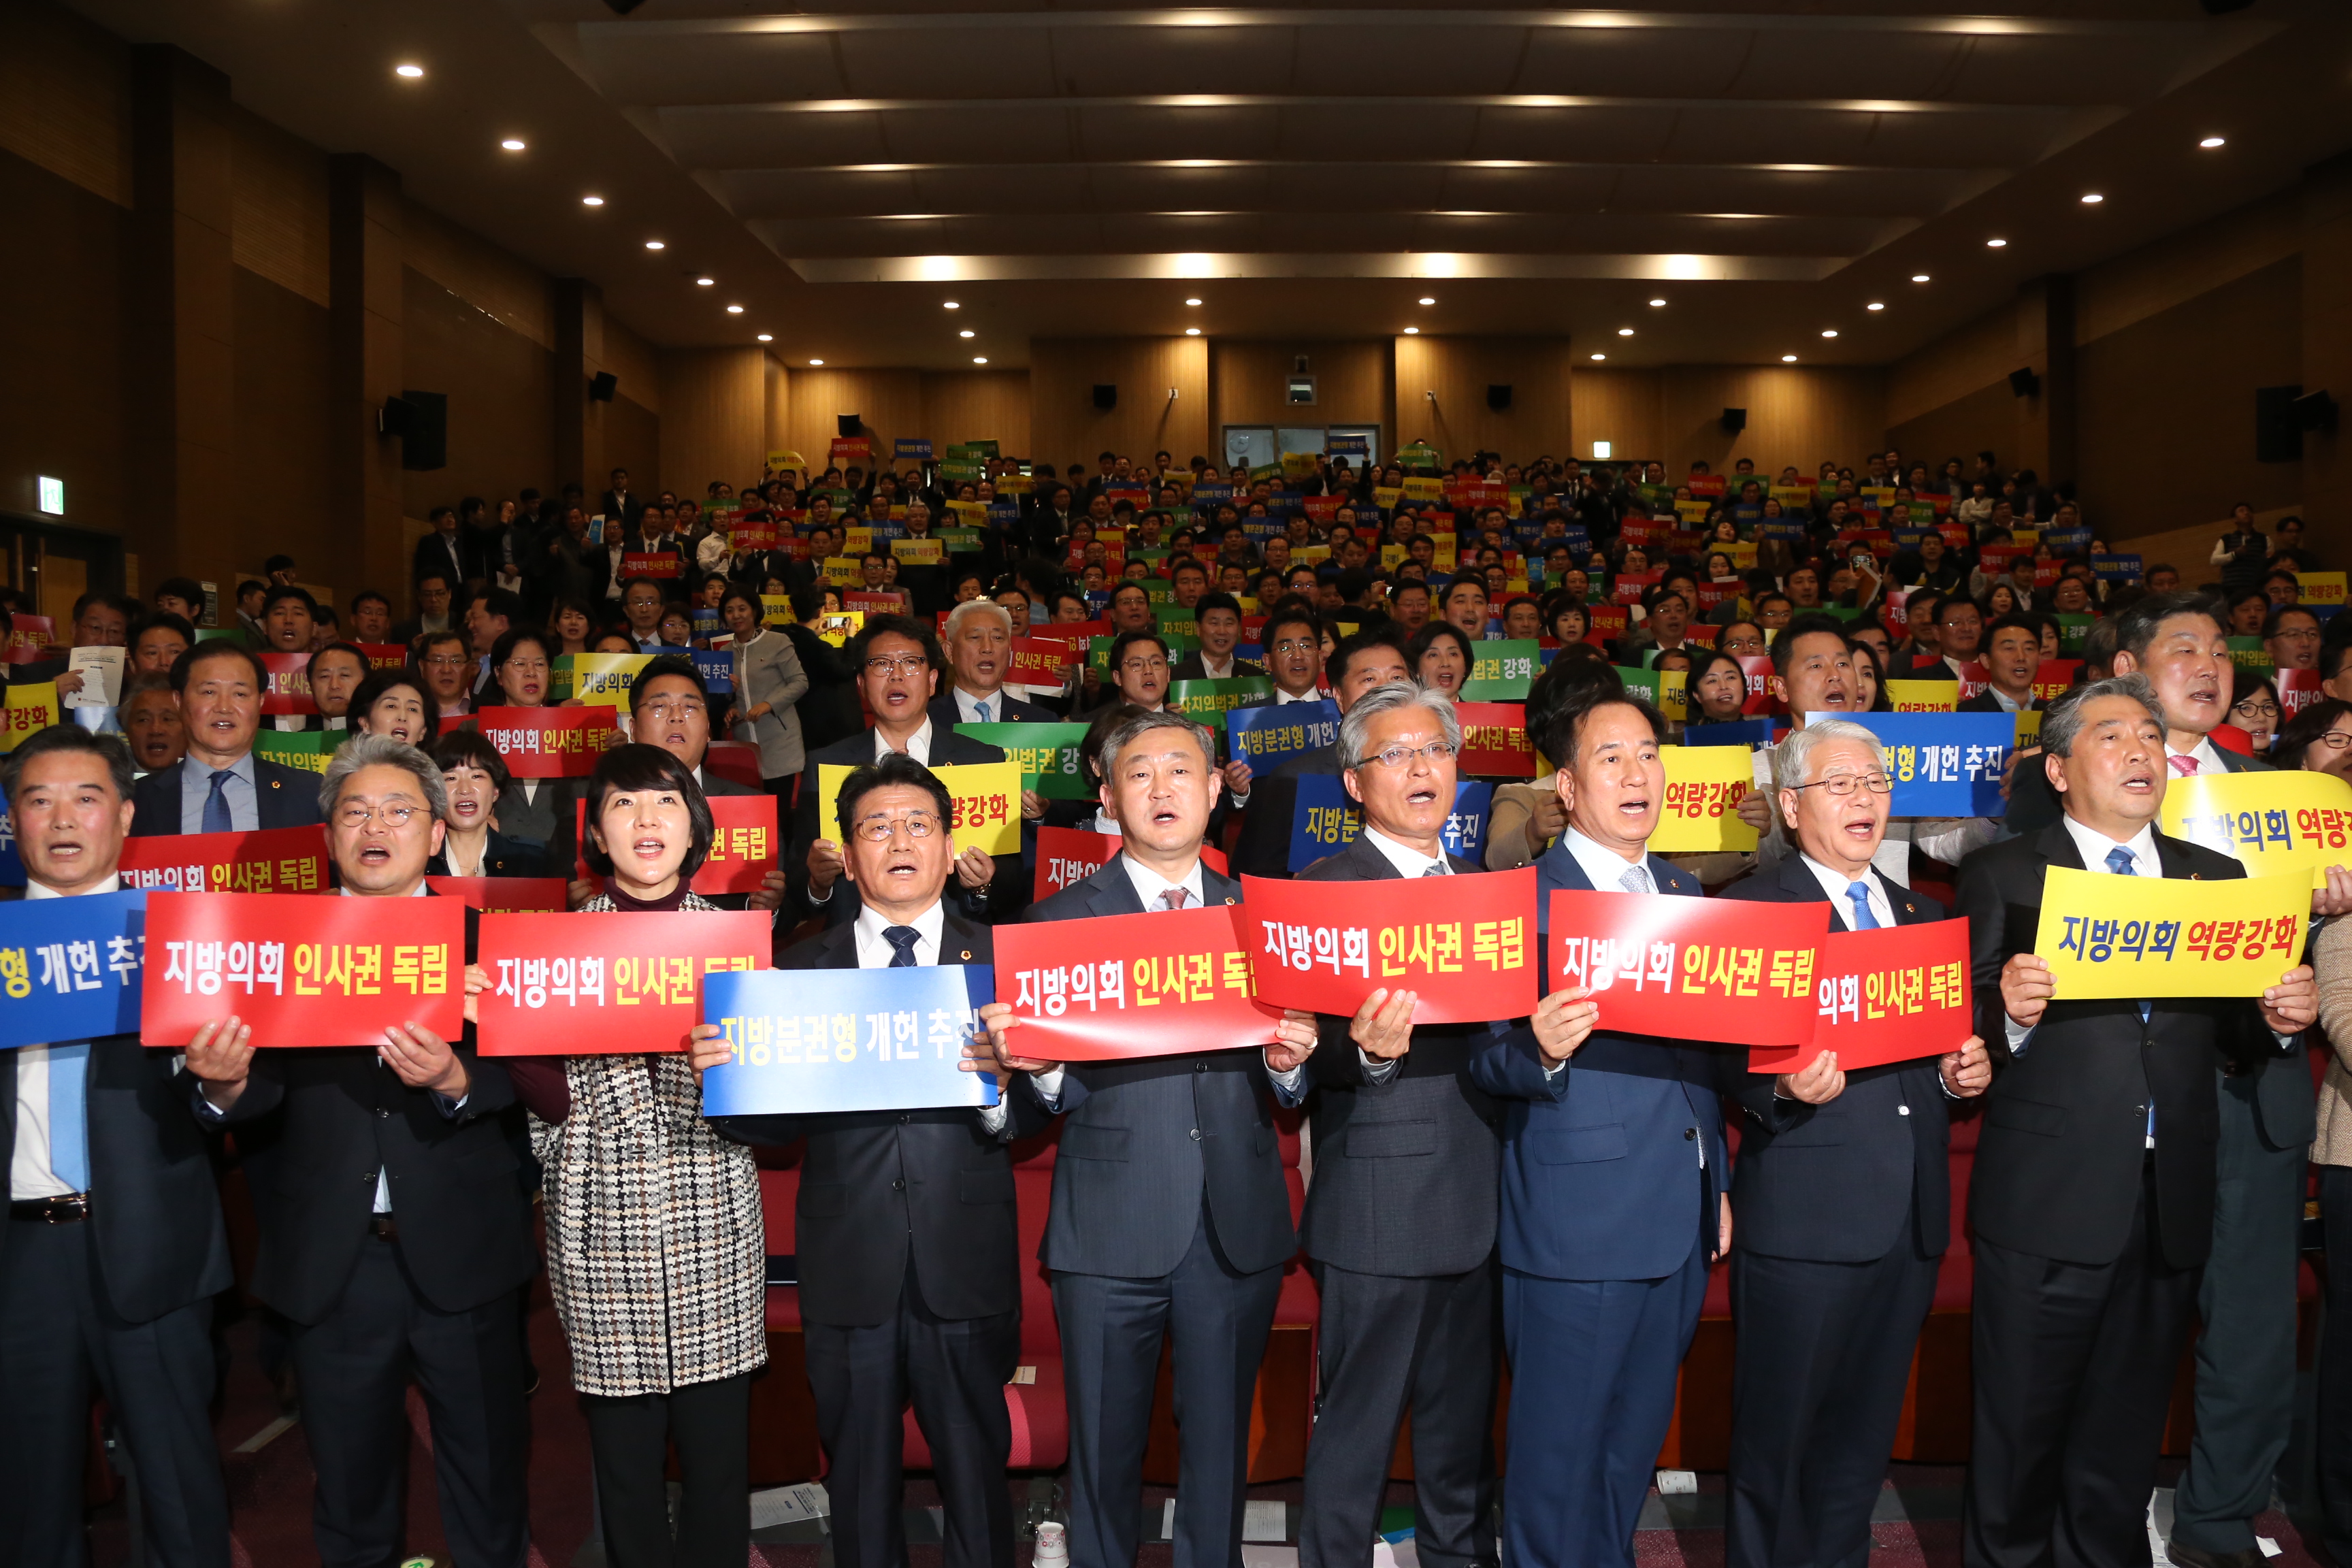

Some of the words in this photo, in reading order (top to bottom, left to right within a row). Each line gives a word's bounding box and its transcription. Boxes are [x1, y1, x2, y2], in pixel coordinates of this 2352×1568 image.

[847, 536, 868, 544] 역량강화
[895, 546, 917, 557] 지방의회
[627, 561, 648, 571] 지방의회
[649, 561, 664, 570] 인사권
[826, 566, 849, 578] 지방의회
[1618, 583, 1642, 595] 지방의회
[1699, 591, 1722, 602] 지방의회
[2308, 583, 2342, 598] 역량강화
[847, 600, 869, 612] 지방의회
[871, 601, 887, 612] 인사권
[1595, 616, 1613, 629] 인사권
[1614, 617, 1626, 630] 독립
[713, 664, 729, 679] 추진
[1015, 652, 1041, 670] 인사권
[1043, 653, 1061, 671] 독립
[1504, 657, 1532, 679] 강화
[582, 672, 633, 693] 지방의회
[1179, 693, 1239, 713] 자치입법권
[486, 729, 539, 755] 지방의회
[543, 728, 583, 754] 인사권
[1237, 726, 1304, 755] 지방분권형
[1307, 721, 1334, 748] 개헌
[1464, 725, 1503, 751] 인사권
[1921, 745, 1959, 782] 개헌
[1964, 745, 2003, 781] 추진
[1667, 781, 1747, 818] 역량강화
[732, 827, 767, 860] 독립
[1445, 813, 1480, 848] 추진
[212, 860, 273, 893] 인사권
[279, 856, 317, 891] 독립
[1262, 920, 1369, 978] 지방의회
[1379, 922, 1463, 977] 인사권
[1473, 917, 1524, 971] 독립
[2059, 916, 2181, 962] 지방의회
[2186, 914, 2298, 962] 역량강화
[35, 940, 102, 994] 개헌
[164, 941, 284, 996] 지방의회
[293, 943, 382, 996] 인사권
[392, 943, 448, 995] 독립
[1563, 936, 1676, 994] 지방의회
[1682, 945, 1763, 997] 인사권
[1769, 948, 1815, 998] 독립
[496, 956, 605, 1008] 지방의회
[614, 956, 693, 1005] 인사권
[1015, 960, 1126, 1017] 지방의회
[1133, 952, 1214, 1006] 인사권
[1865, 966, 1923, 1019] 인사권
[1929, 961, 1963, 1009] 독립
[721, 1013, 858, 1066] 지방분권형
[866, 1009, 919, 1062] 개헌
[928, 1008, 980, 1059] 추진
